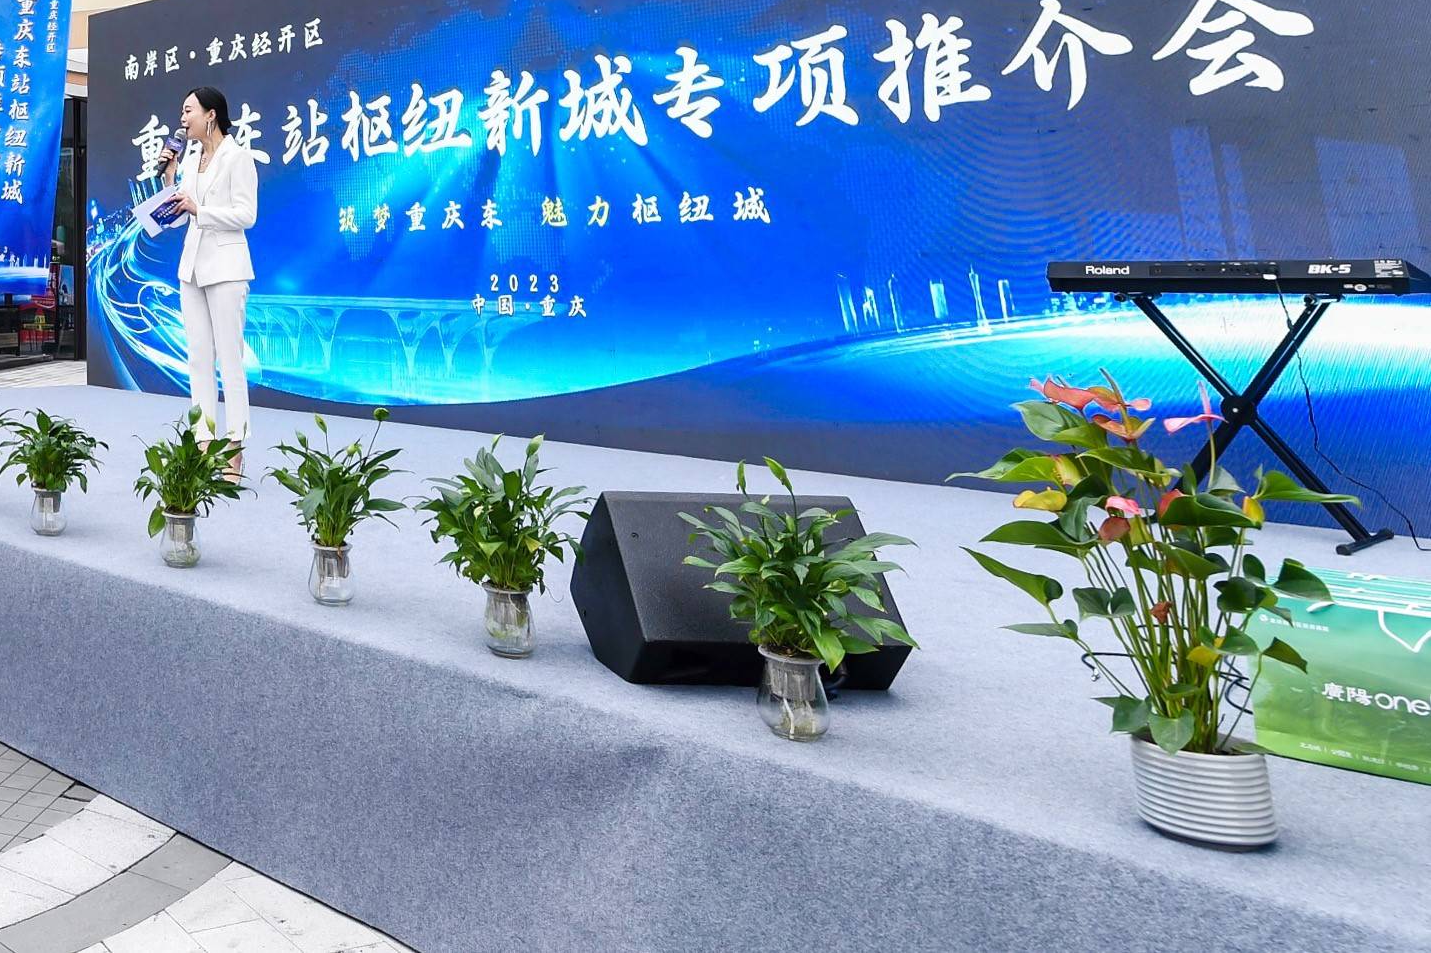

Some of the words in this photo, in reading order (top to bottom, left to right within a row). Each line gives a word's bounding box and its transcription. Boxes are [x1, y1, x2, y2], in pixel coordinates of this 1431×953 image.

[124, 18, 324, 81] 南岸区·重庆经开区
[338, 199, 503, 233] 筑梦重庆东
[541, 186, 771, 228] 魅力枢纽城
[1085, 264, 1130, 276] Roland
[1307, 264, 1352, 275] BK-5
[490, 274, 560, 293] 2023
[471, 293, 588, 318] 中国·重庆
